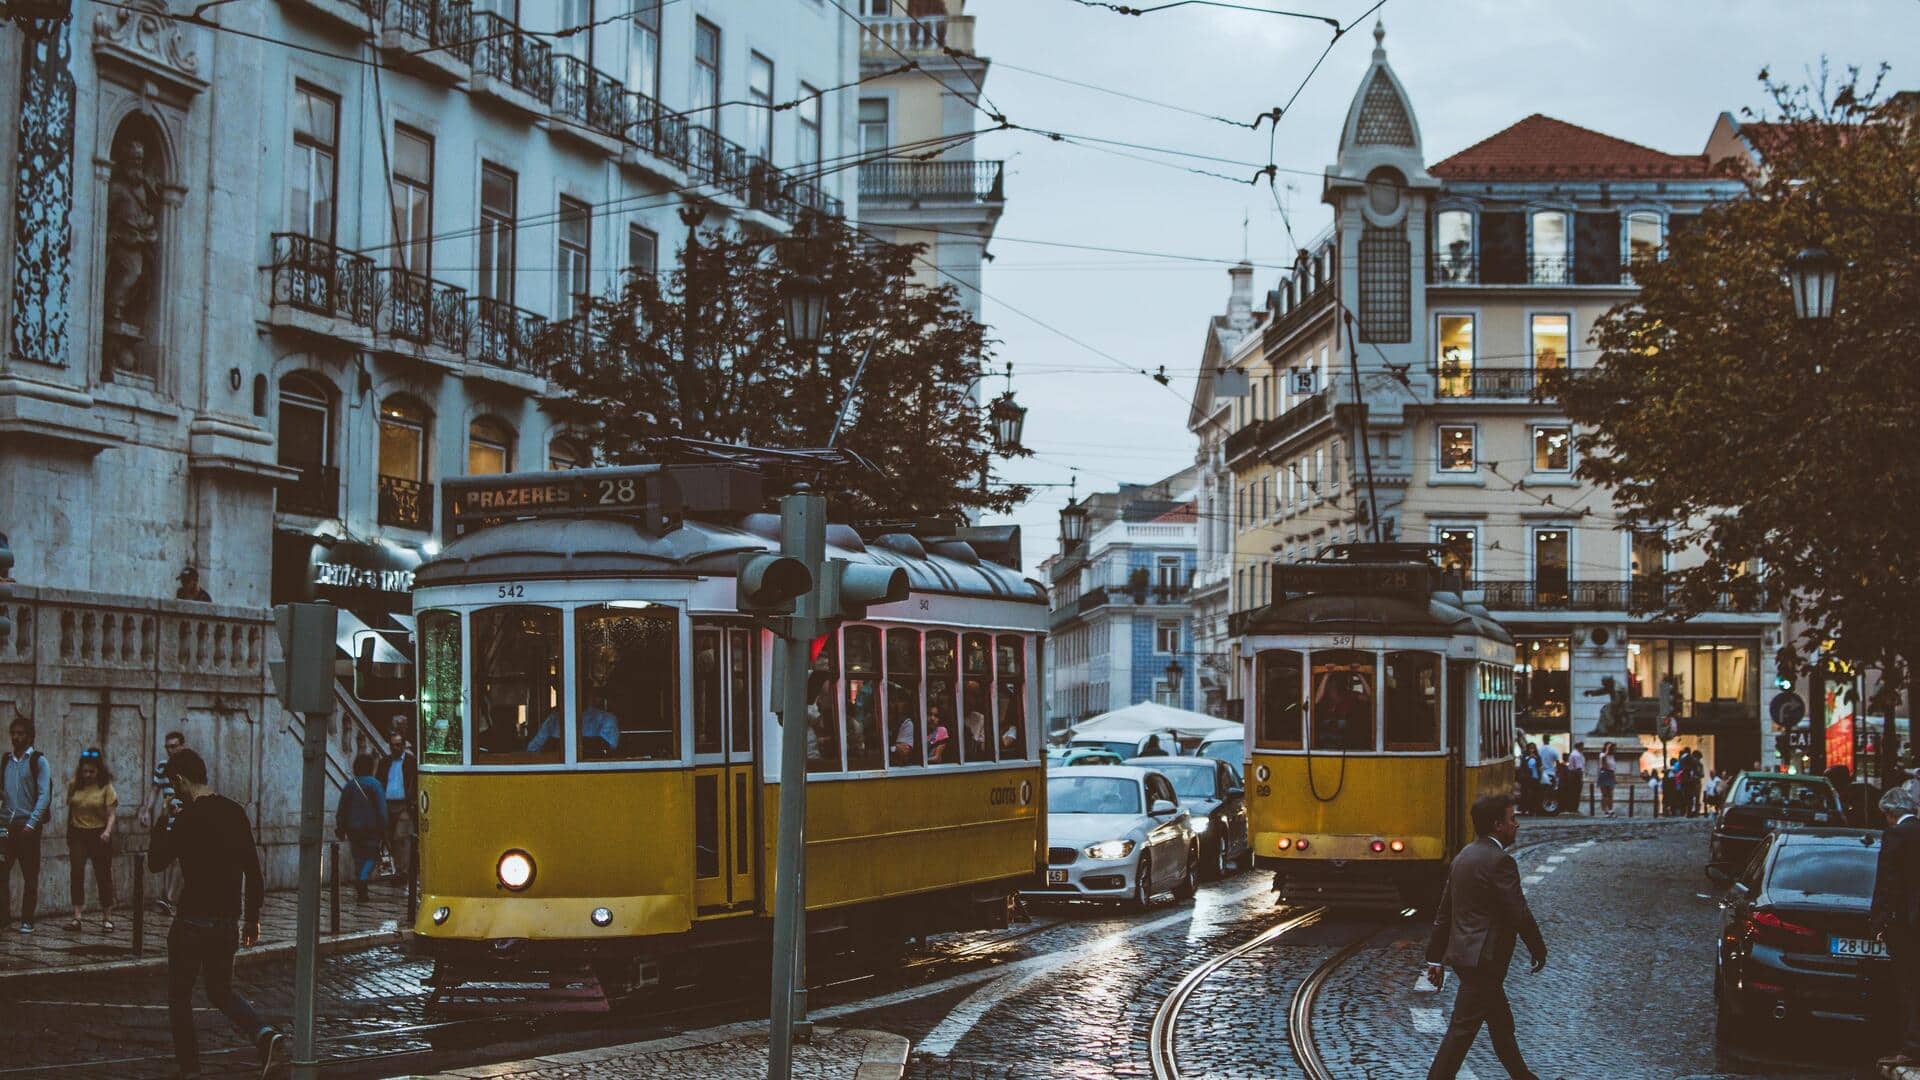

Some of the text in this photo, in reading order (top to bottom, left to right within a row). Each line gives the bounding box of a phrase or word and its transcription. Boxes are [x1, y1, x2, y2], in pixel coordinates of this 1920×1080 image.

[466, 479, 636, 508] PRAZERES 28
[498, 585, 525, 599] 542
[1332, 636, 1350, 646] 549
